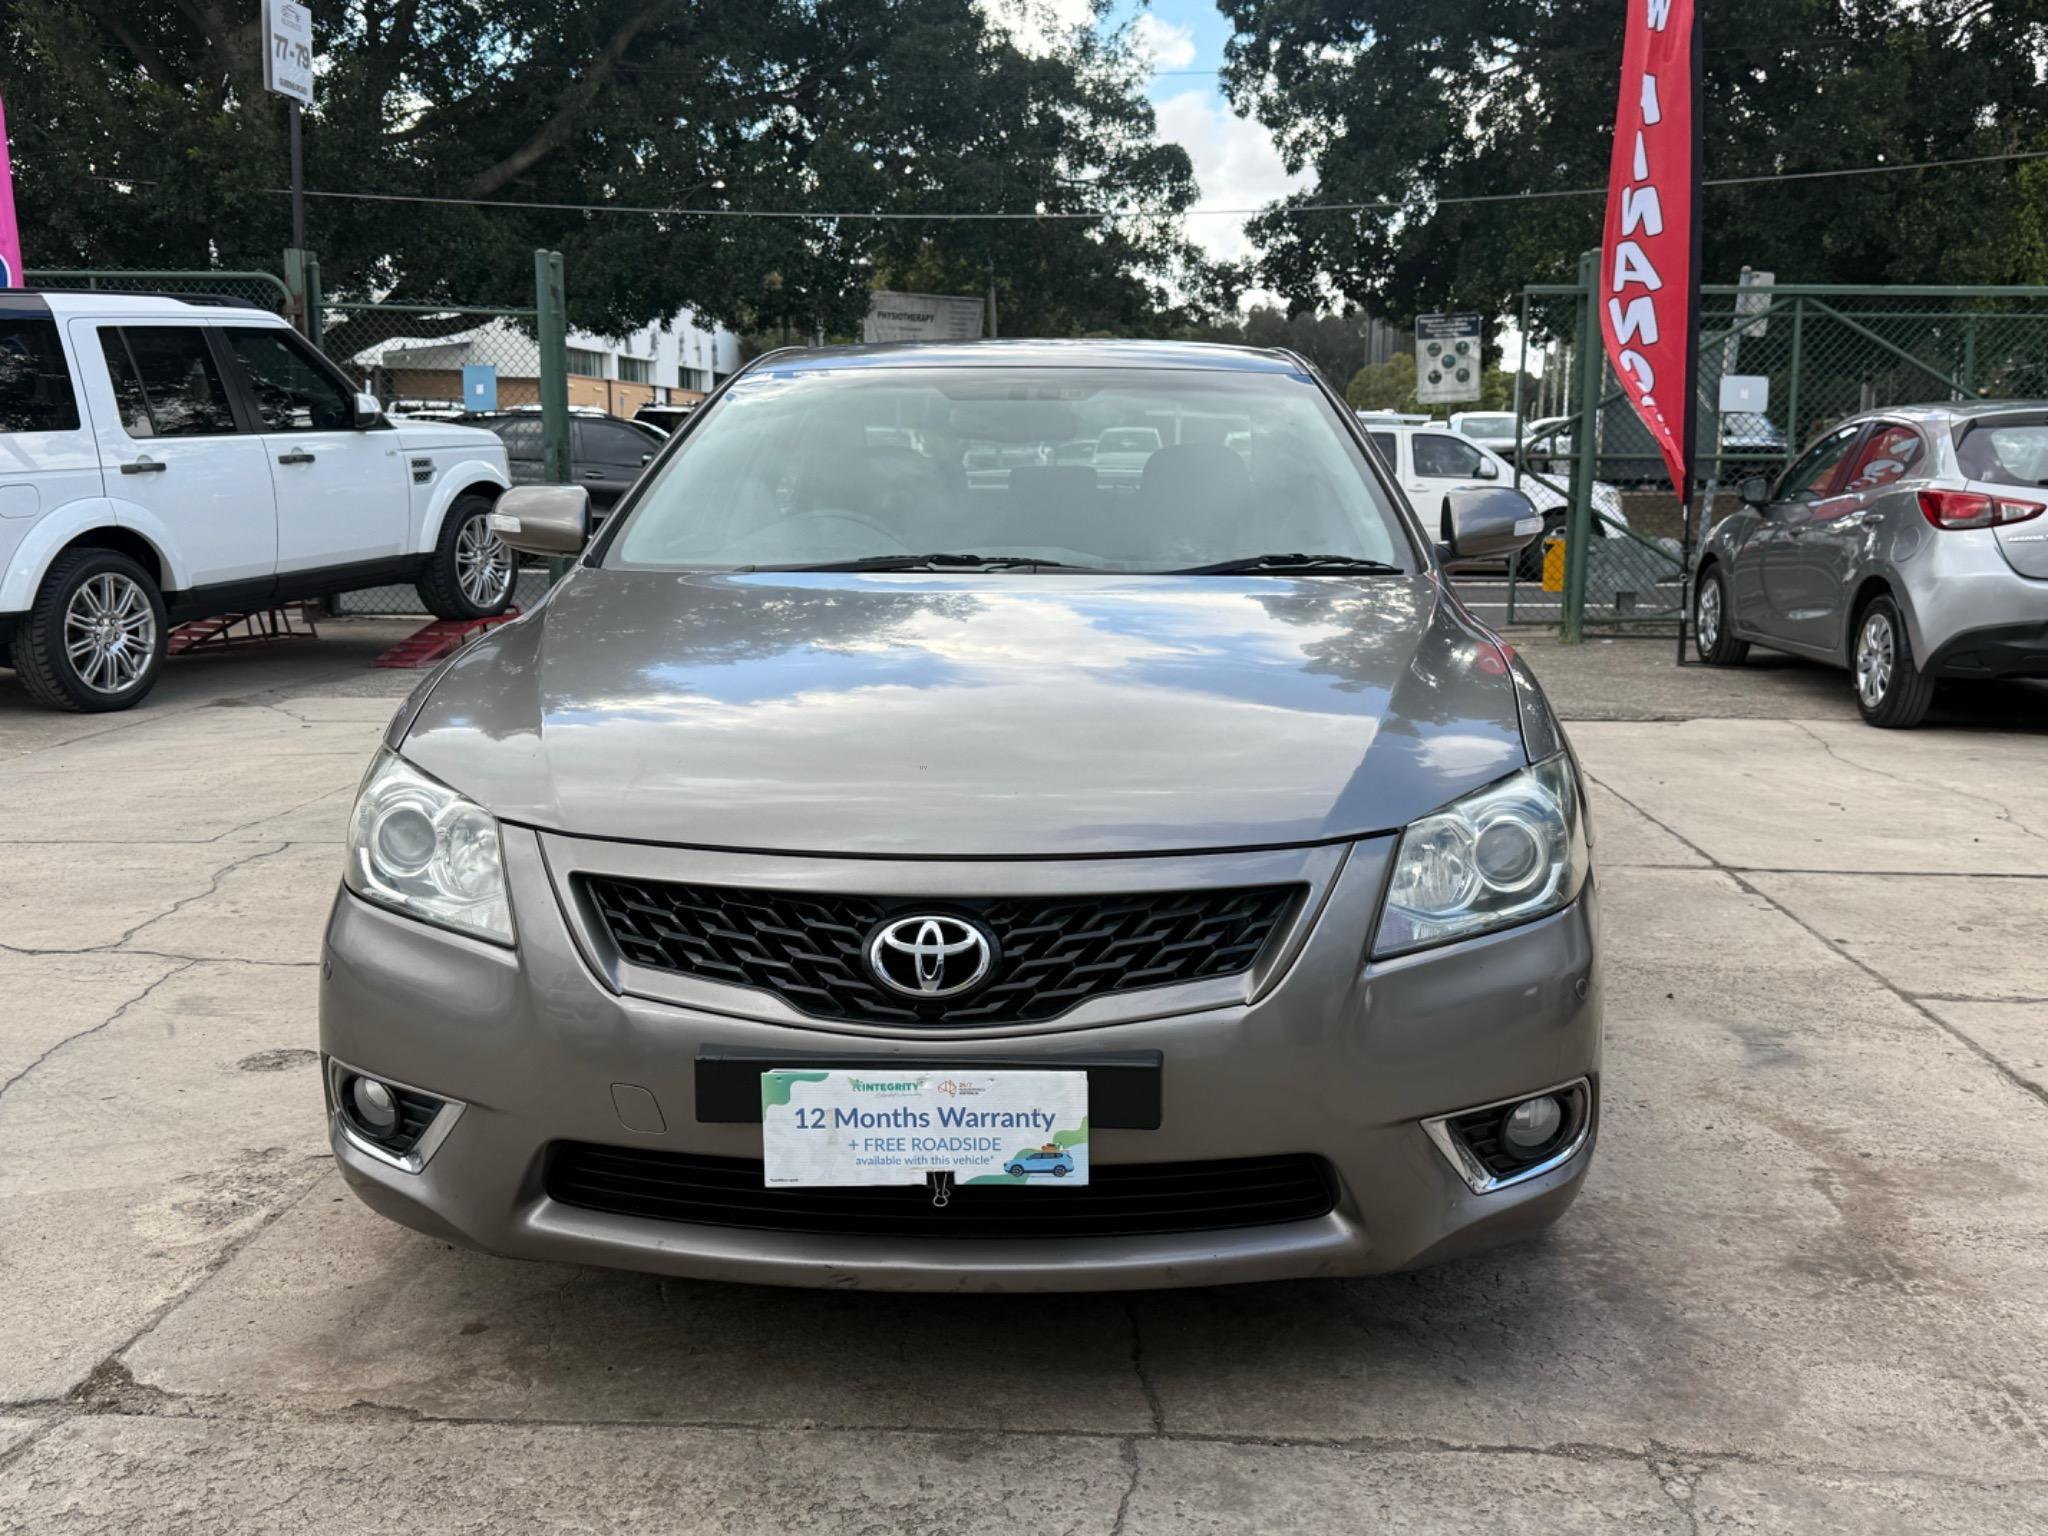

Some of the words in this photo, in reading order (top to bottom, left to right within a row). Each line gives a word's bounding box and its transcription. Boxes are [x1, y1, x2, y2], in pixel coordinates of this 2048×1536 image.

[877, 311, 934, 322] PHYSIOTHERAPY
[862, 1082, 918, 1092] INTEGRITY
[794, 1107, 826, 1129] 12
[834, 1106, 930, 1129] Months
[937, 1107, 1056, 1132] Warranty
[848, 1139, 859, 1151] +
[864, 1137, 906, 1151] FREE
[911, 1137, 1002, 1151] ROADSIDE
[855, 1155, 901, 1166] available
[904, 1155, 928, 1165] with
[931, 1154, 951, 1165] this
